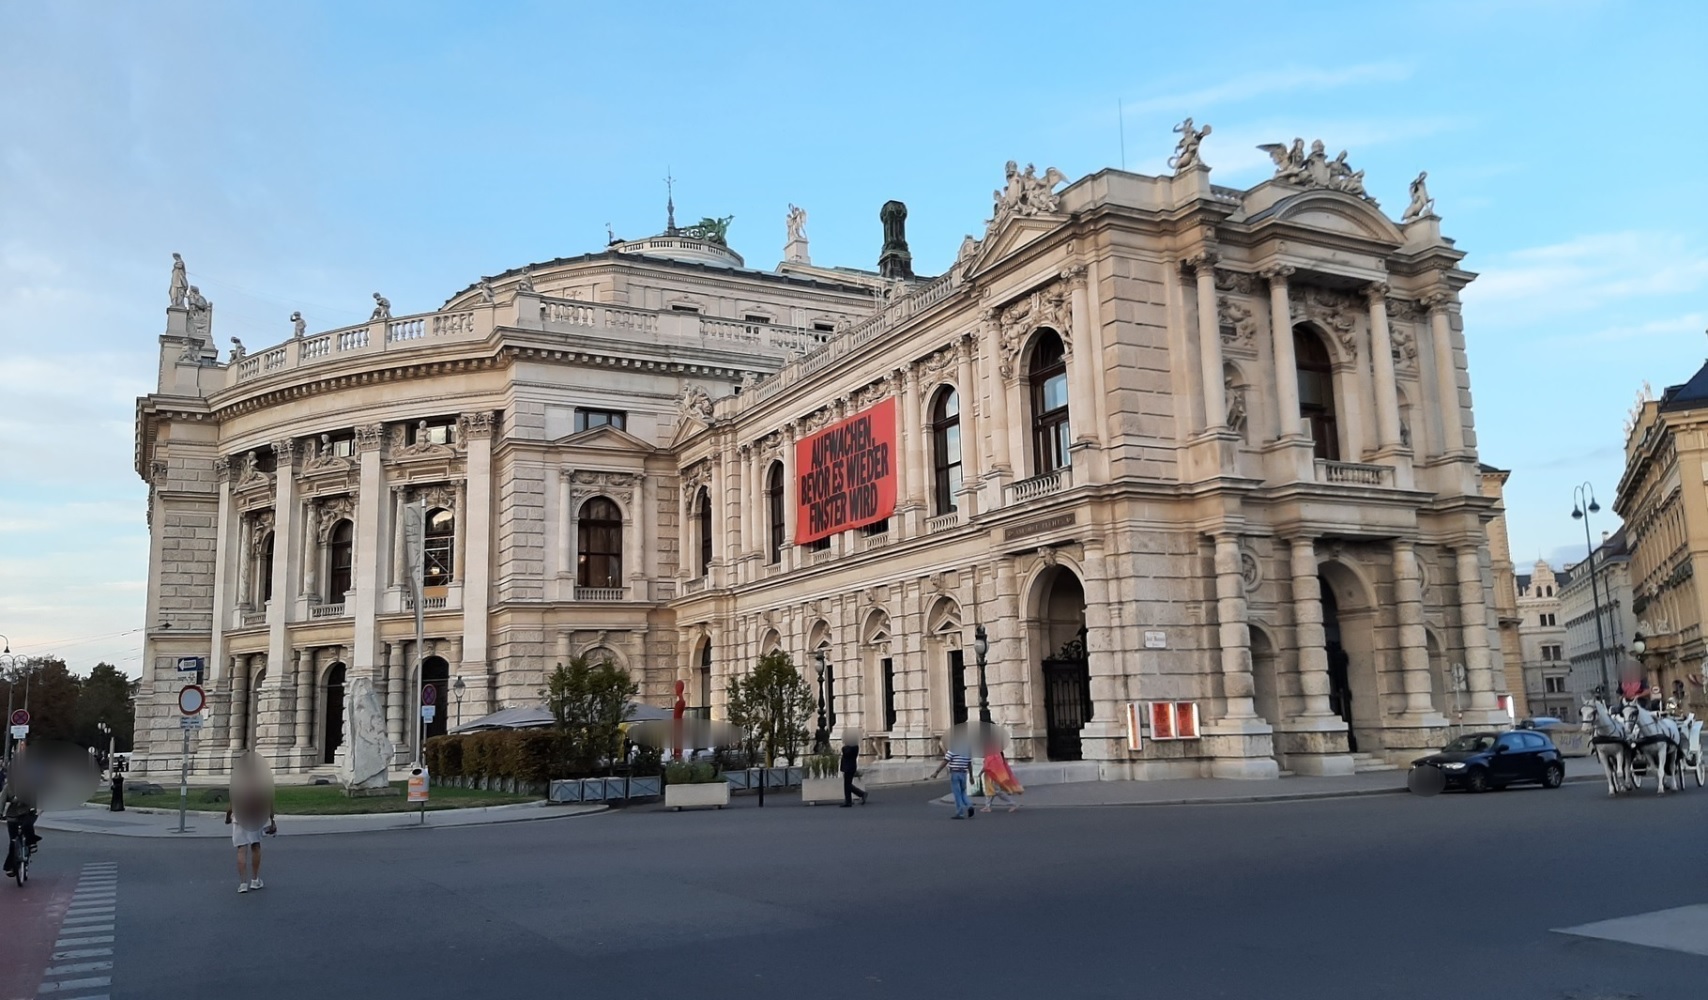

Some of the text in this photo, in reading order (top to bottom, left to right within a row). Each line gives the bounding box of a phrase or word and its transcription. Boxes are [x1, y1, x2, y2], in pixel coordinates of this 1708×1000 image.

[811, 415, 875, 471] AUFWACHEN,
[801, 441, 889, 506] BEVOR ES WIEDER
[809, 482, 878, 536] FINSTER WIRD
